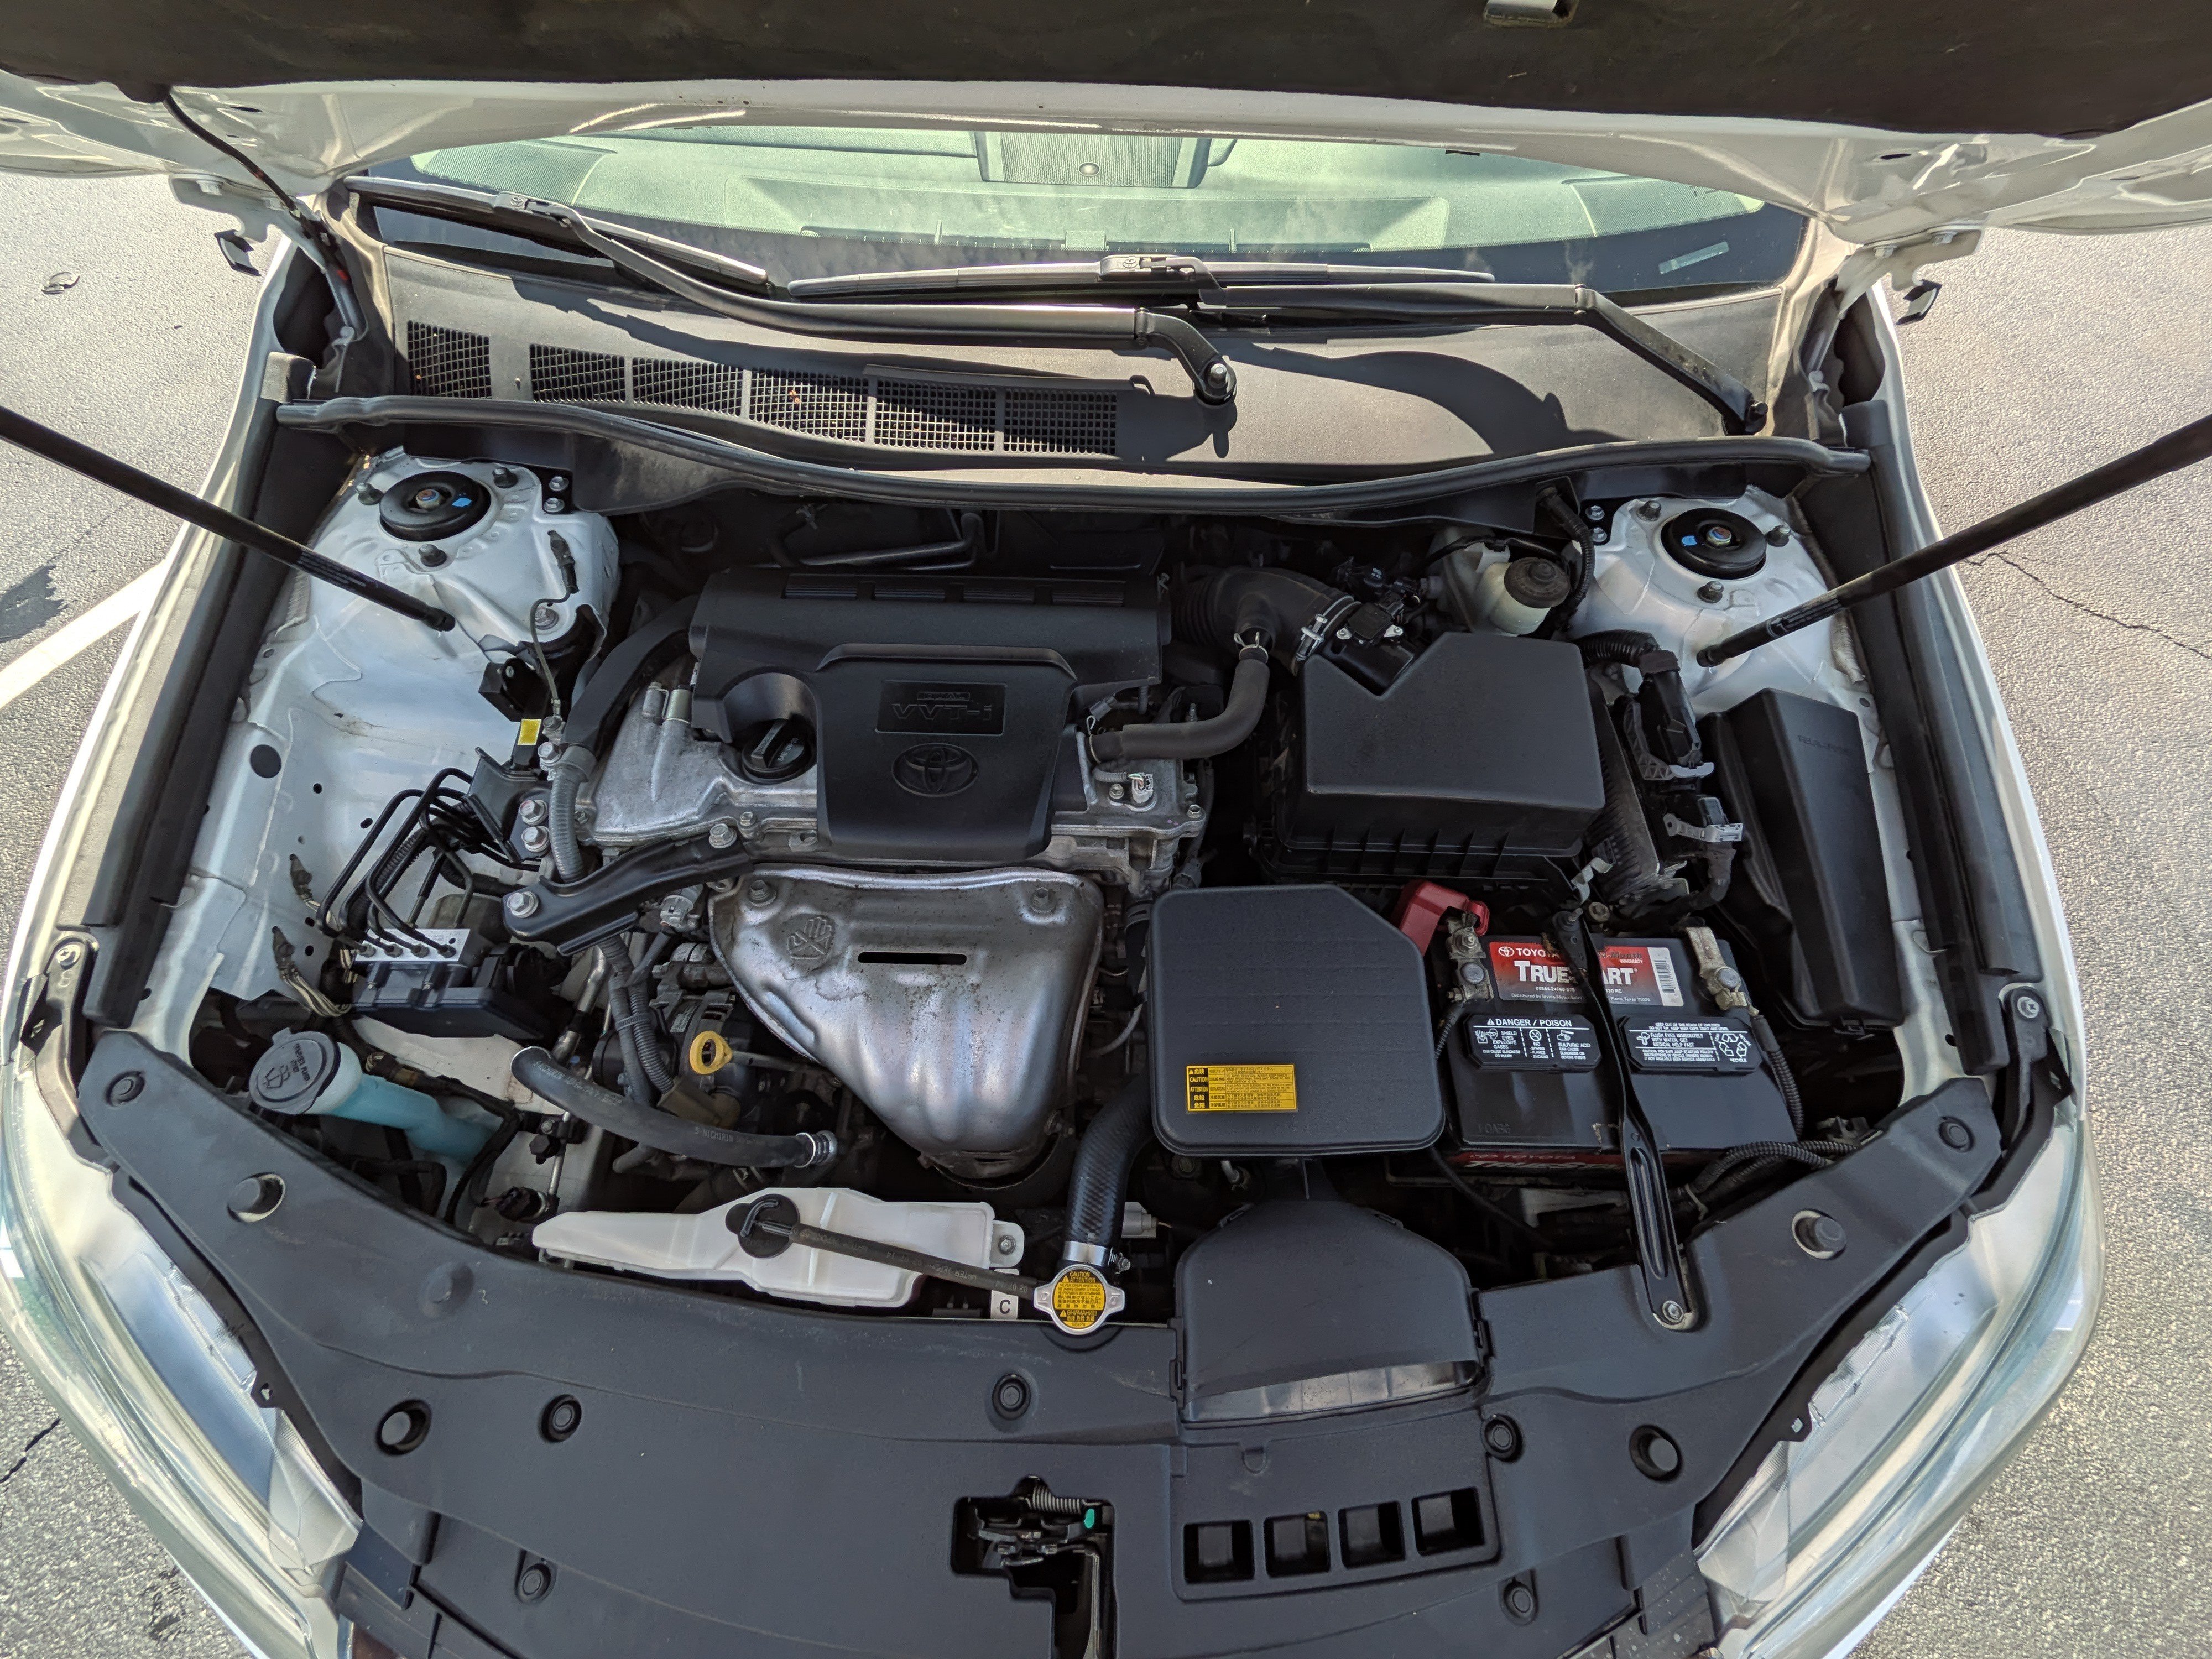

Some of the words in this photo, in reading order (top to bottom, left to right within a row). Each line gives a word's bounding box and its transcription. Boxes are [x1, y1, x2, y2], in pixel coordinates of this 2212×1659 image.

[891, 703, 992, 721] VVT-i
[1495, 1018, 1531, 1026] DANGER
[999, 1299, 1011, 1314] C
